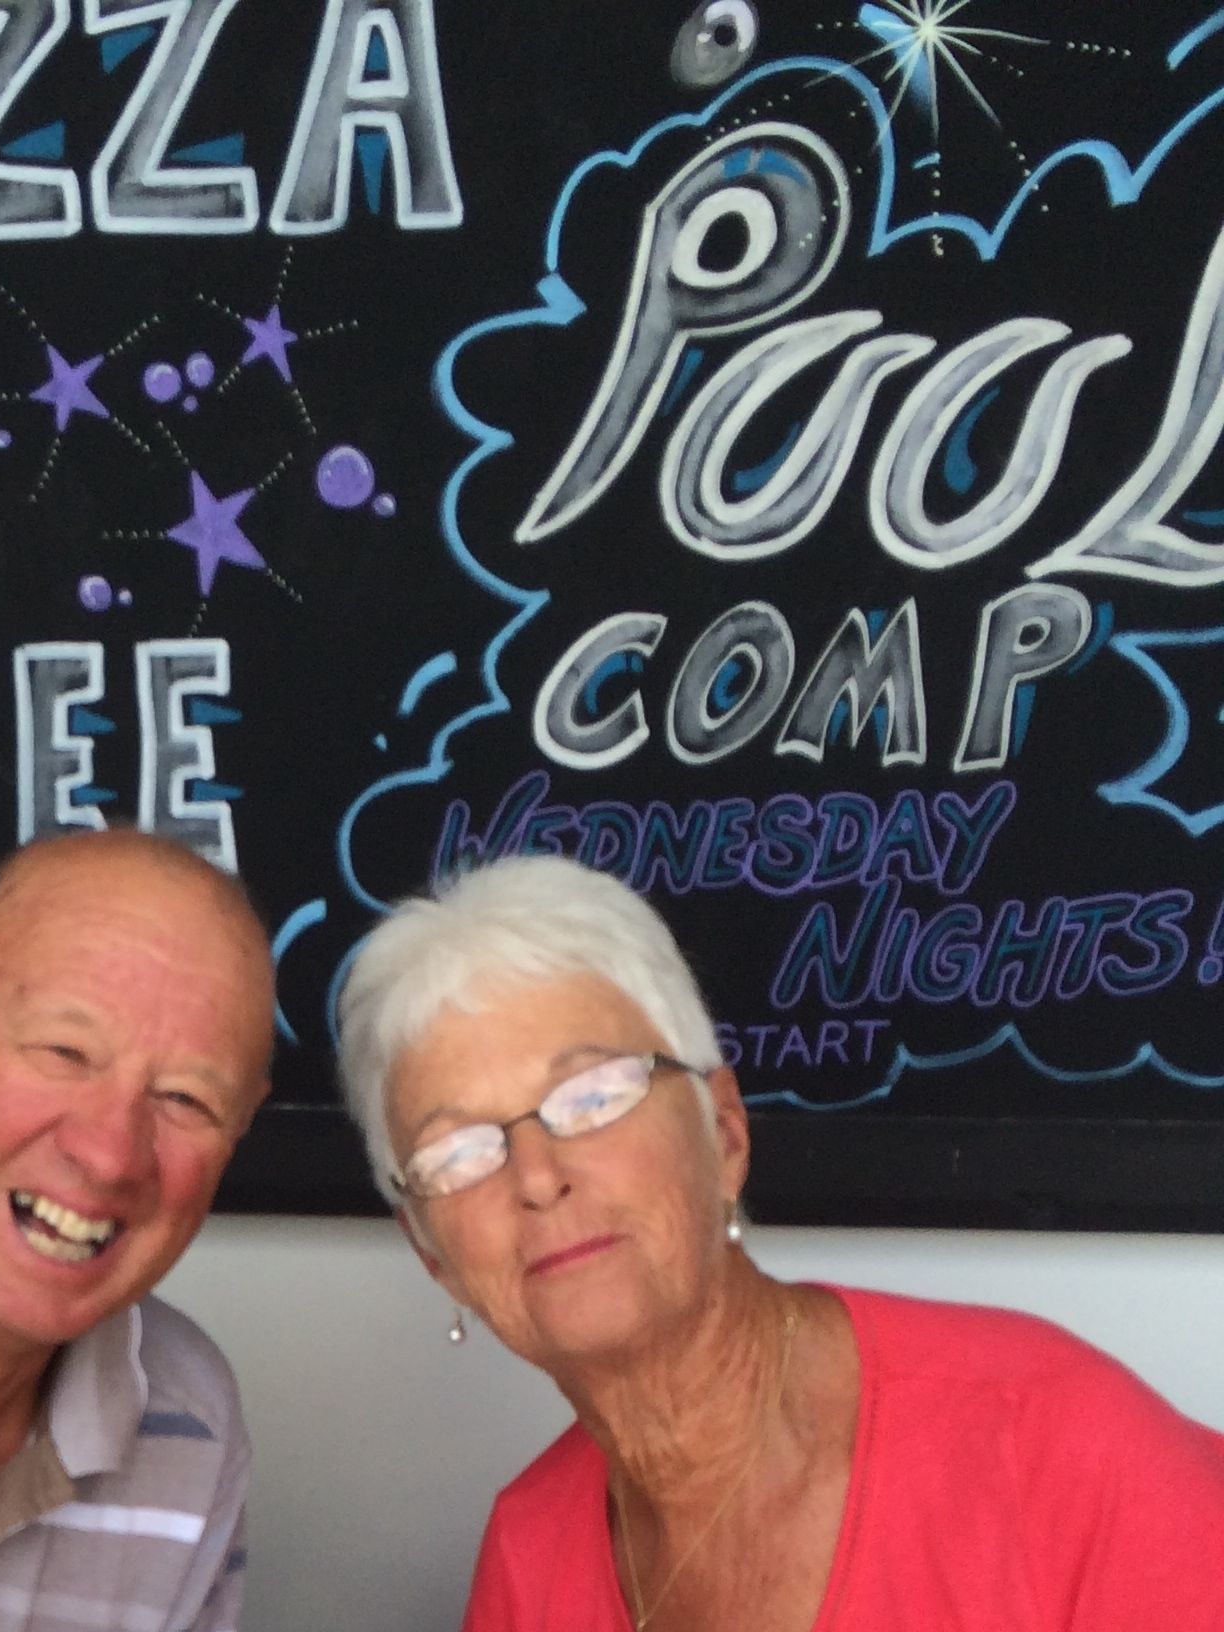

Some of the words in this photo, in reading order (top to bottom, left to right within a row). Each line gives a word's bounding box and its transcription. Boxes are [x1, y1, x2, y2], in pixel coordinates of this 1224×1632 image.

[533, 582, 1092, 772] COMP
[430, 770, 1016, 896] WEDNESDAY
[713, 1018, 892, 1070] START
